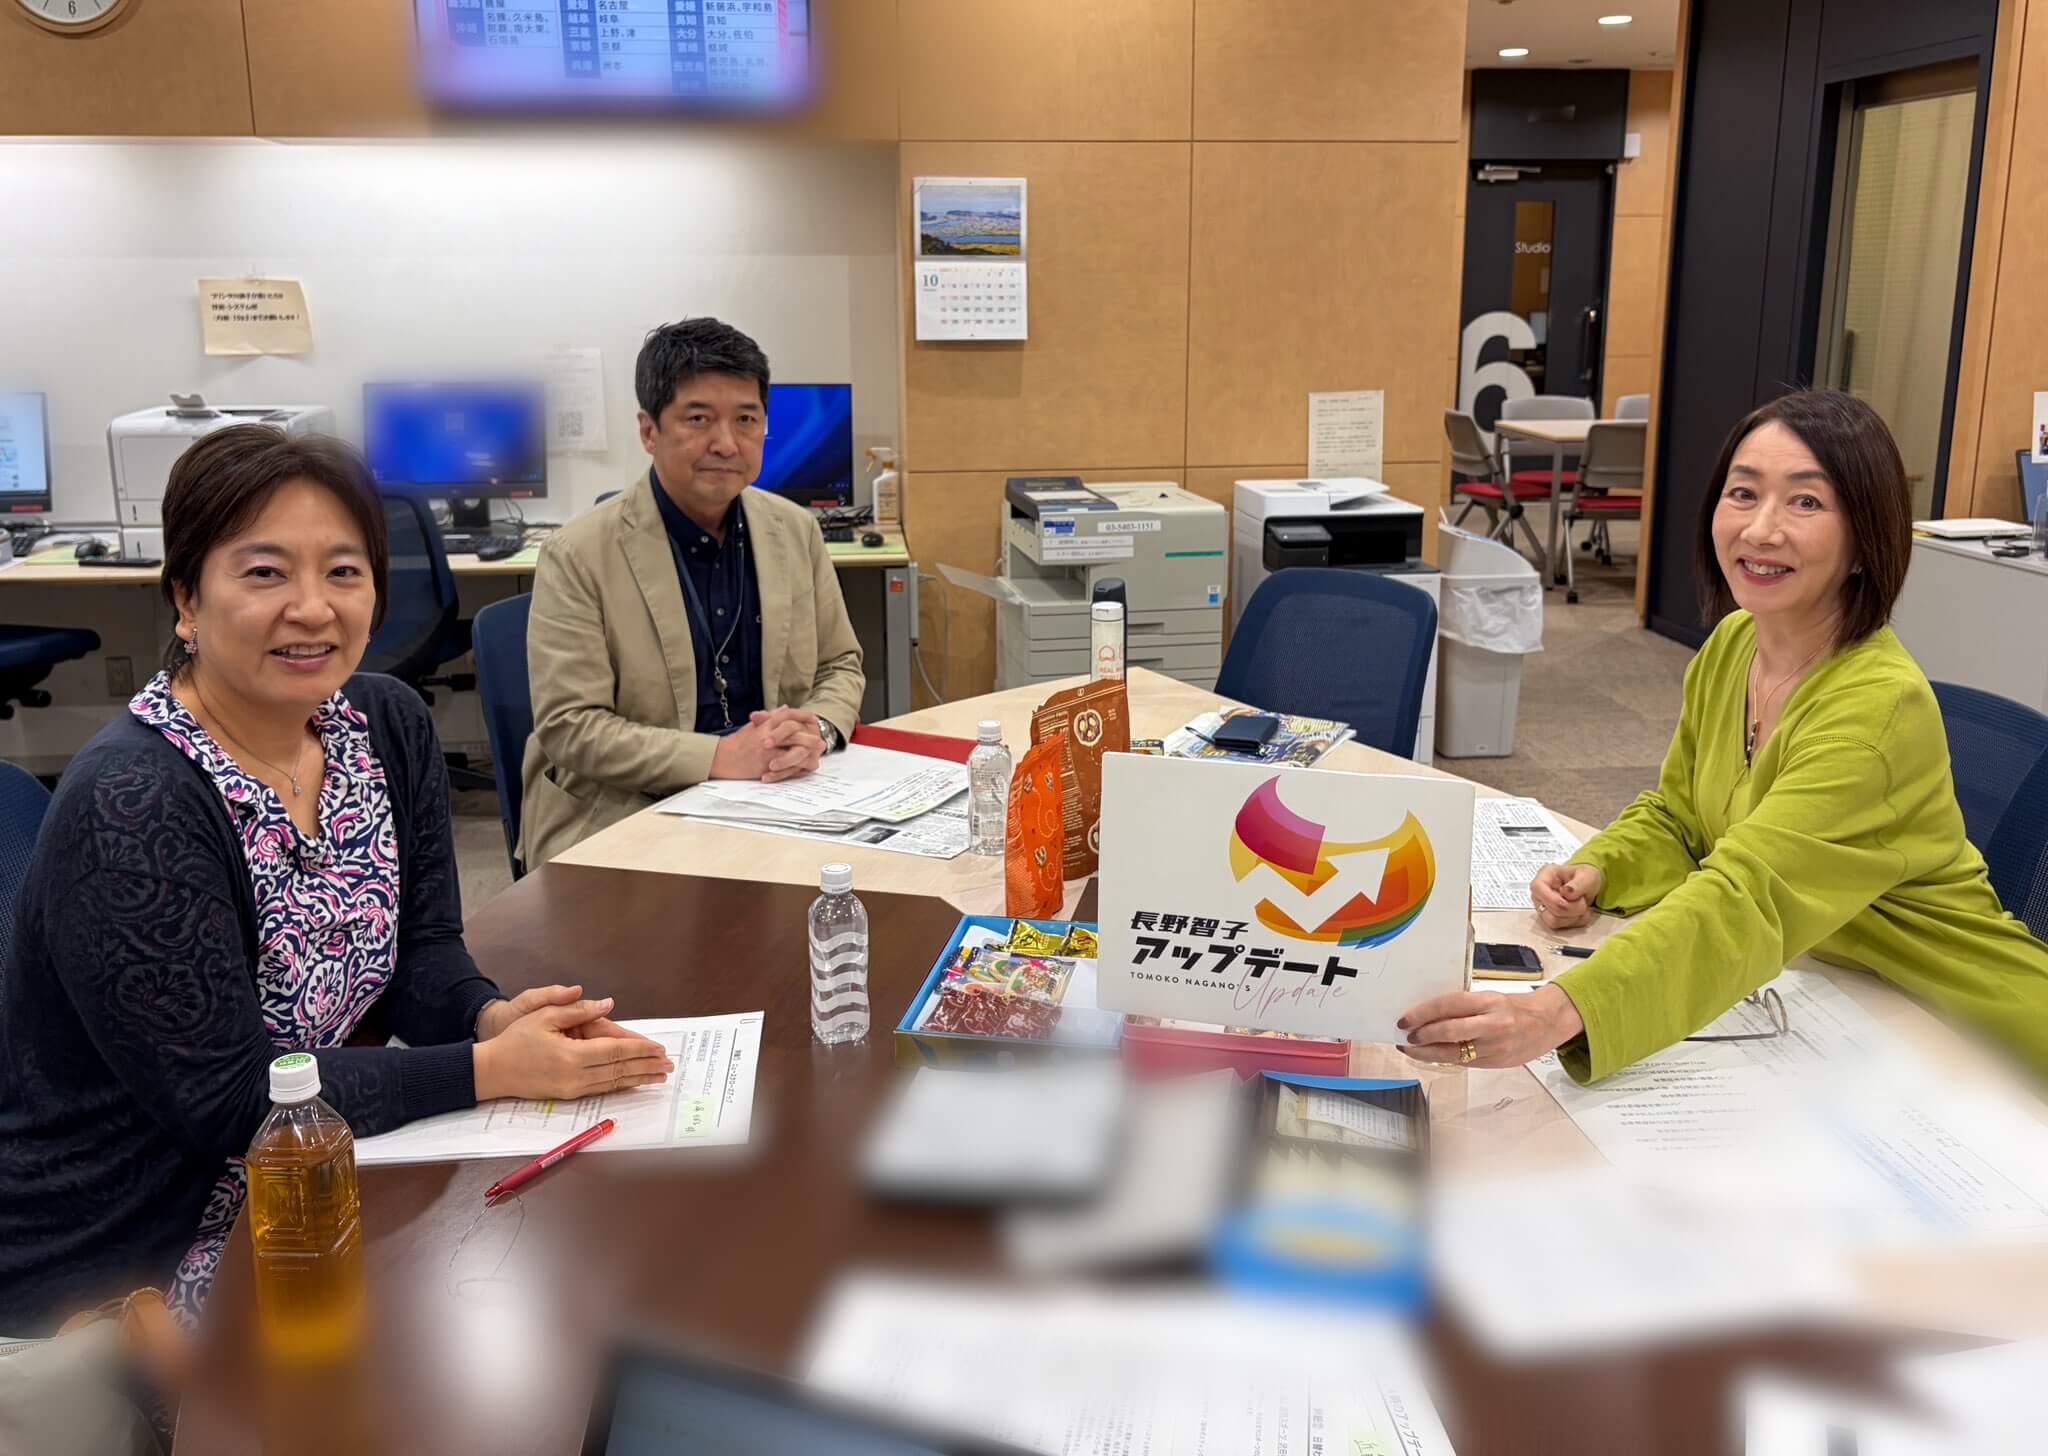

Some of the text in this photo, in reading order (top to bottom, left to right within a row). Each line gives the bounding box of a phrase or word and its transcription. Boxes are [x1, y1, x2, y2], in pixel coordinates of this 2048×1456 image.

[67, 0, 77, 16] 6
[599, 1, 629, 10] 名古屋
[1514, 241, 1552, 254] Studio
[923, 274, 939, 287] 10
[1458, 311, 1537, 456] 6
[1130, 911, 1249, 940] 長野智子
[1132, 936, 1358, 986] アップデート
[1130, 971, 1179, 984] TOMOKO
[1233, 962, 1350, 1020] Update
